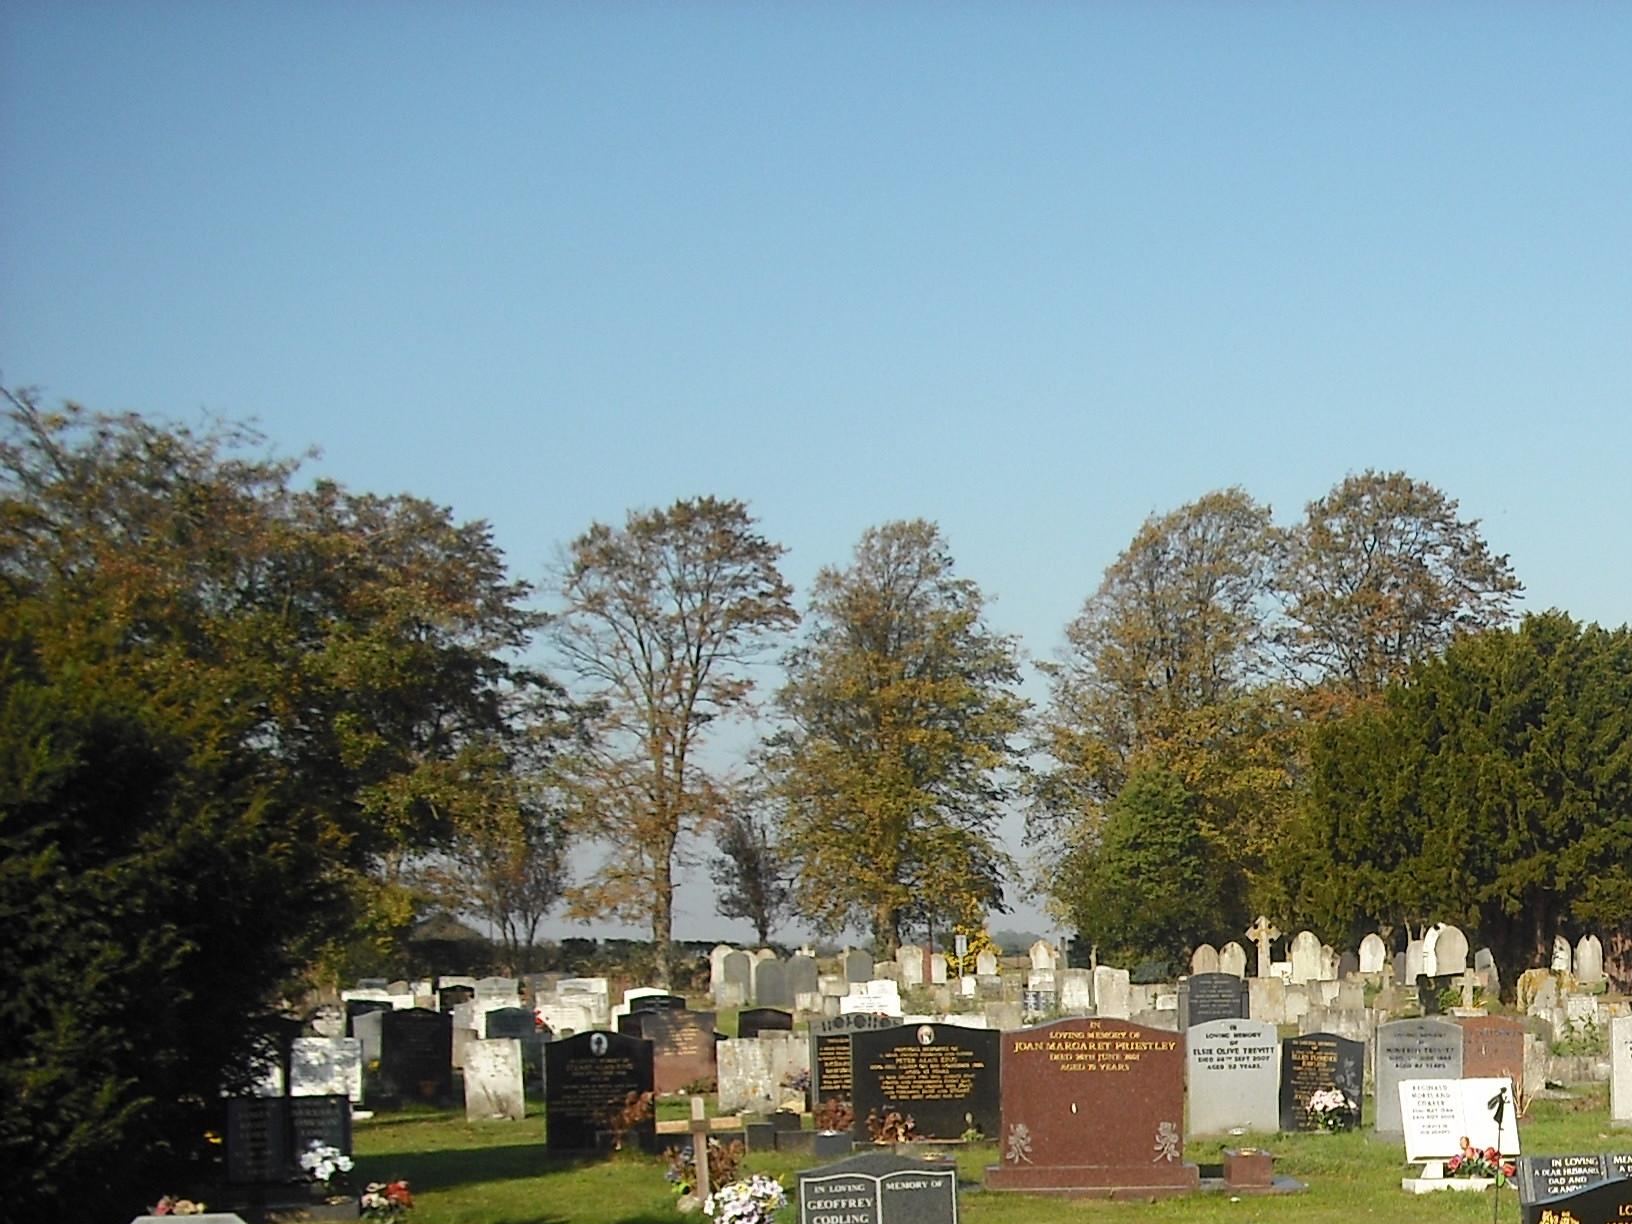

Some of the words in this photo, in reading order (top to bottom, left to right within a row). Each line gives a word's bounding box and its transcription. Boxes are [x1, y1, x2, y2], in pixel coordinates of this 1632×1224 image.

[1087, 1031, 1127, 1039] MEMORY
[1014, 1042, 1044, 1052] JOAN
[1046, 1041, 1111, 1050] MARGARET
[1115, 1041, 1176, 1050] PRIESTLEY
[1060, 1063, 1086, 1071] AGED
[1099, 1063, 1130, 1071] YEARS
[1551, 1159, 1562, 1167] IN
[1564, 1157, 1599, 1166] LOVING
[1541, 1168, 1562, 1177] DEAR
[1548, 1177, 1566, 1185] DAD
[1568, 1176, 1587, 1184] AND
[814, 1186, 825, 1194] IN
[829, 1184, 866, 1193] LOVING
[885, 1181, 929, 1191] MEMORY
[930, 1180, 944, 1188] OF
[806, 1197, 874, 1210] GEOFFREY
